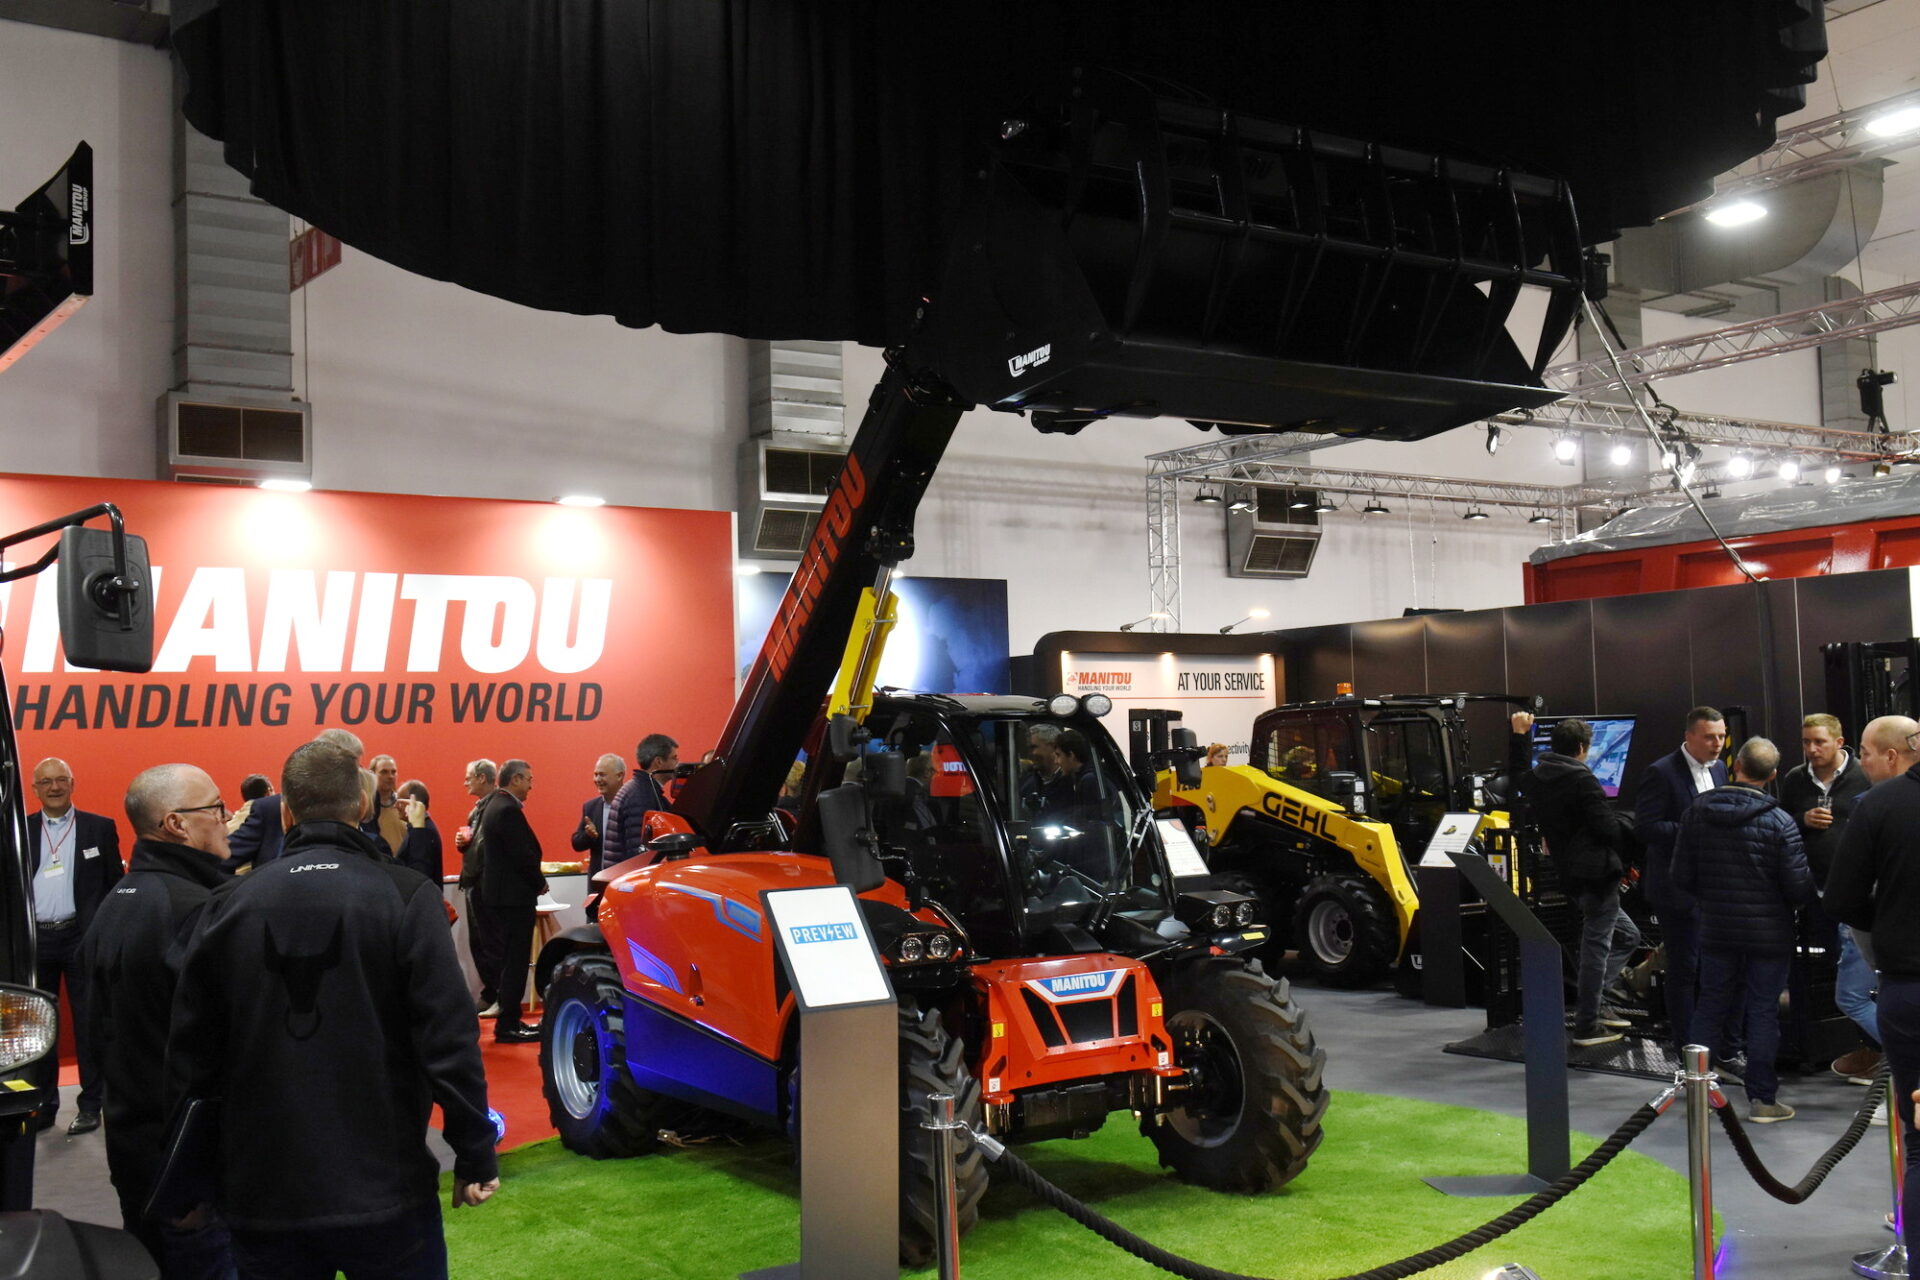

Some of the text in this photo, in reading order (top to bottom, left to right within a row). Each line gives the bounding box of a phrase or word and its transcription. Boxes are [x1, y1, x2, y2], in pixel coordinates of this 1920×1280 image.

[72, 183, 83, 237] MANITOU
[1015, 343, 1051, 370] MANITOU
[762, 451, 867, 684] MANITOU
[1079, 671, 1132, 685] MANITOU
[1178, 672, 1265, 691] AT YOUR SERVICE
[15, 682, 604, 731] HANDLING YOUR WORLD
[1262, 791, 1337, 842] GEHL
[290, 863, 340, 873] UNIMOG
[1052, 974, 1106, 993] MANITOU
